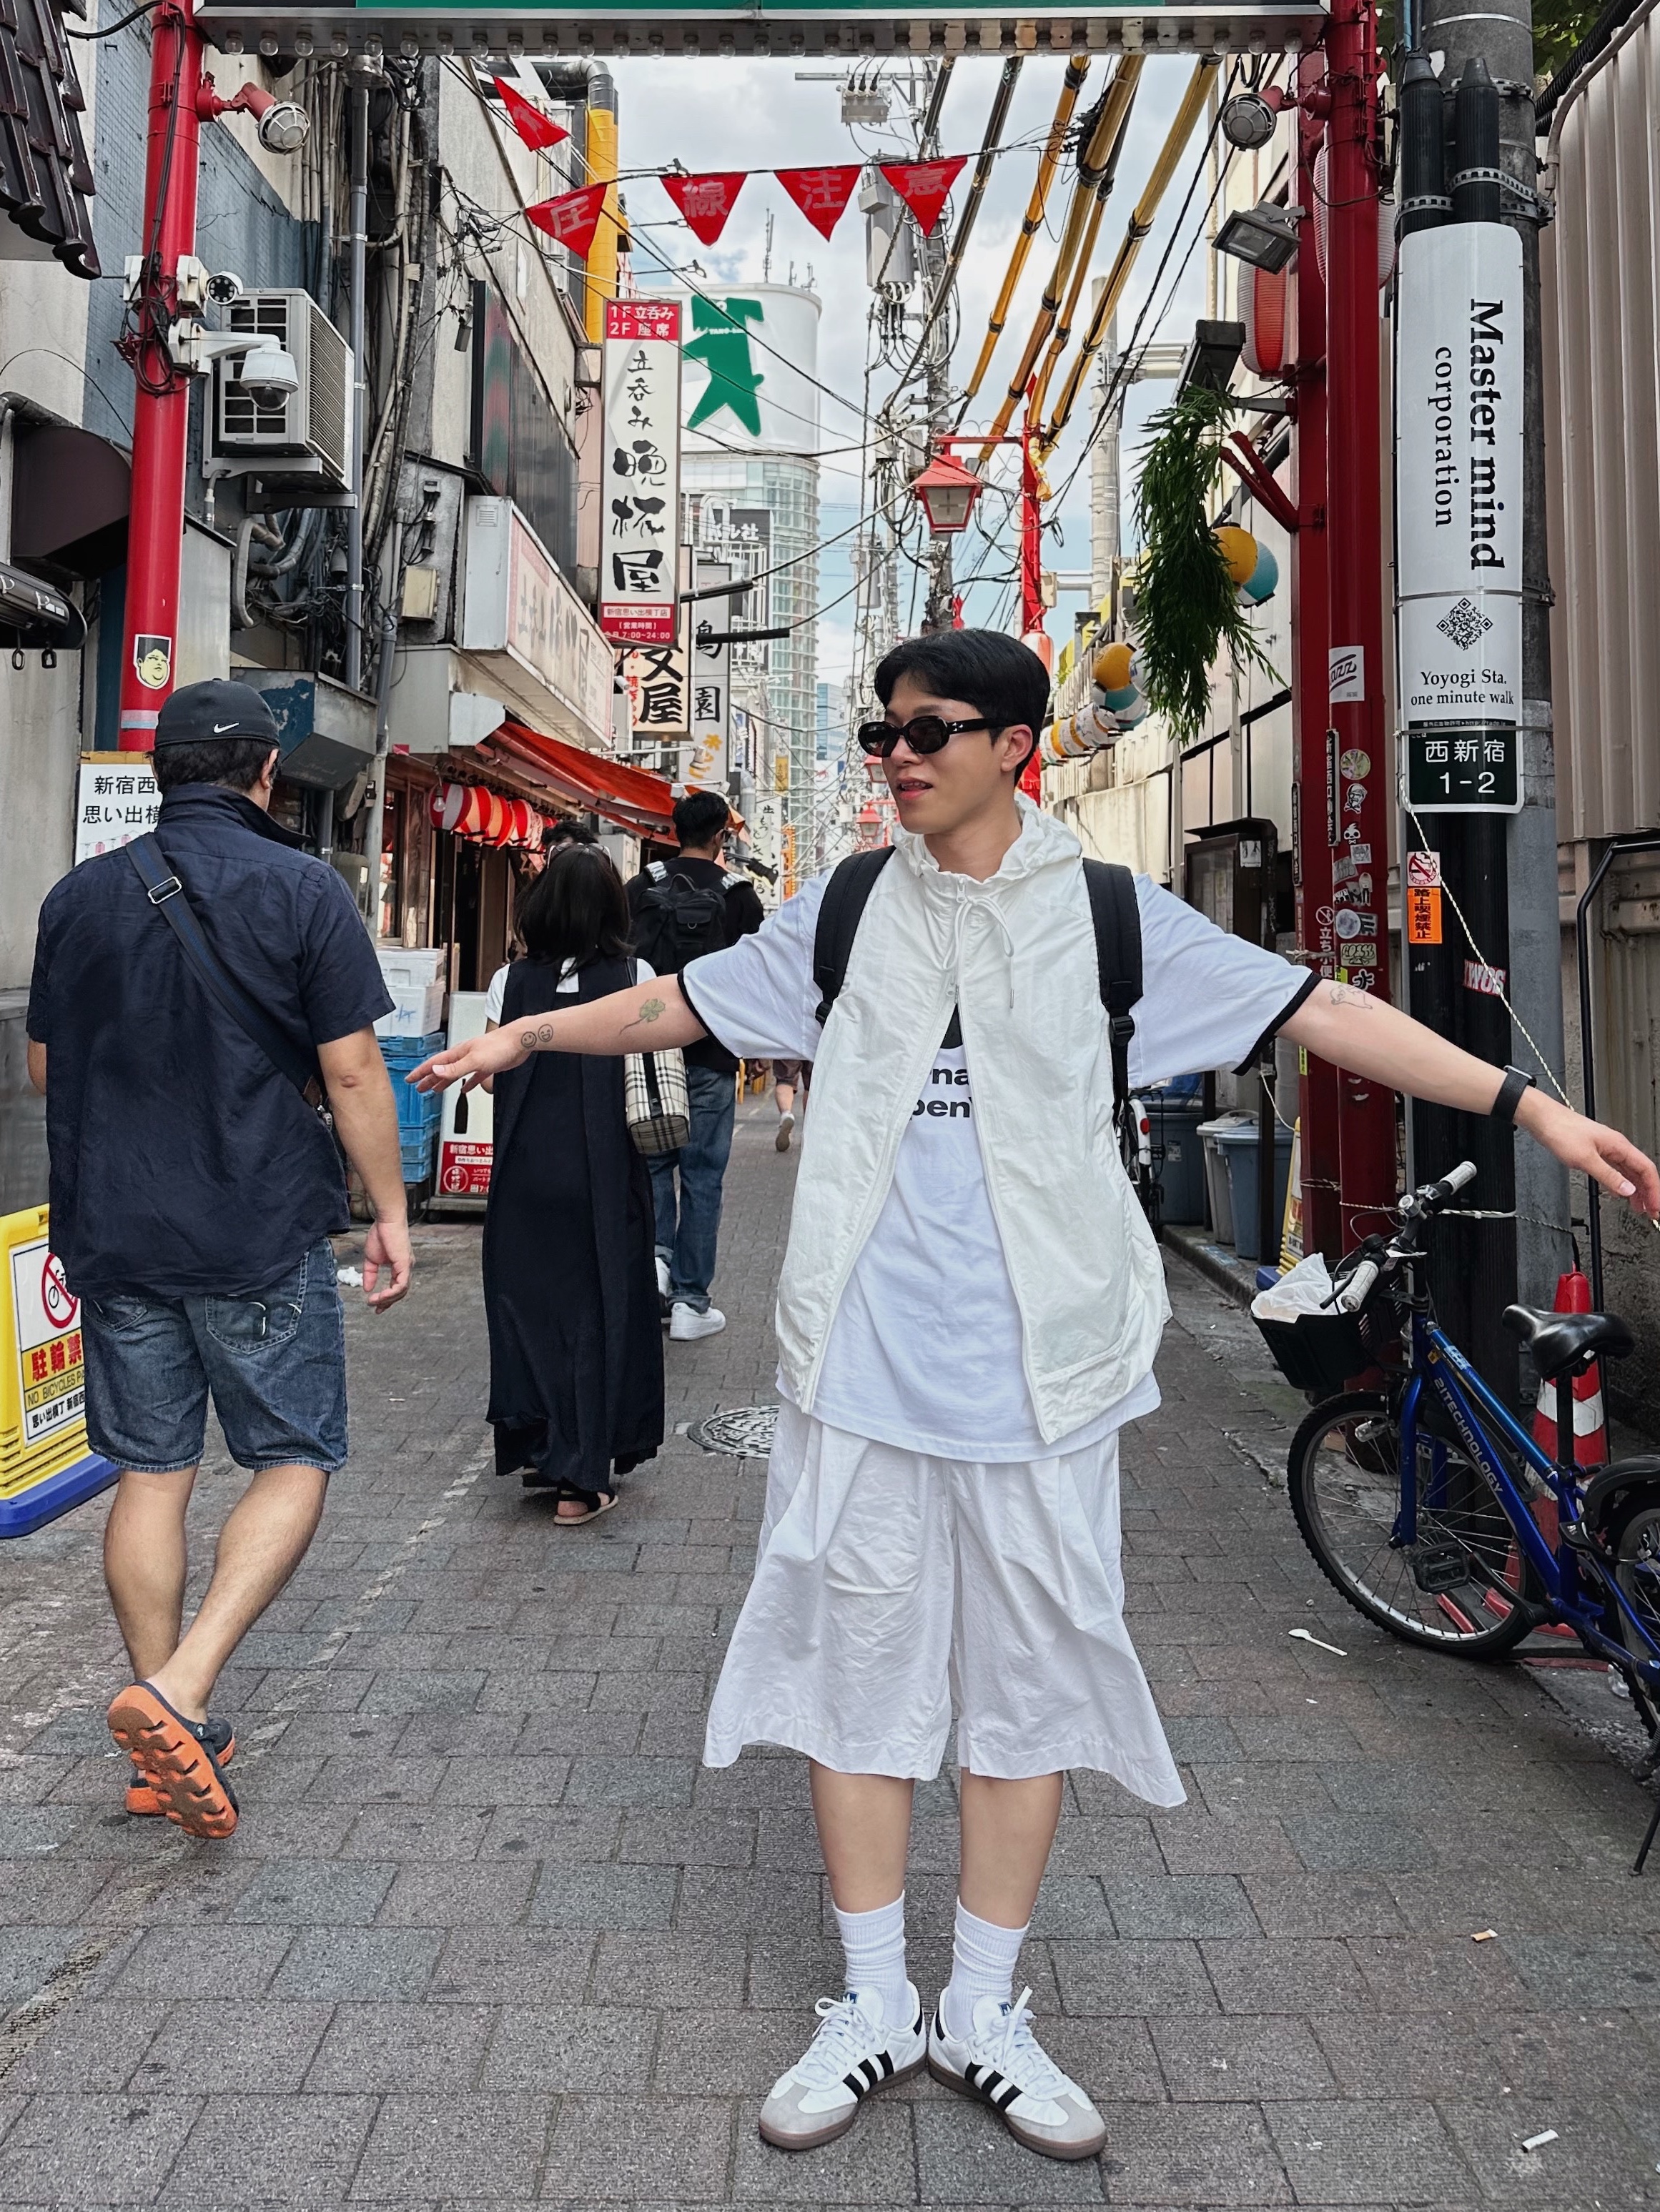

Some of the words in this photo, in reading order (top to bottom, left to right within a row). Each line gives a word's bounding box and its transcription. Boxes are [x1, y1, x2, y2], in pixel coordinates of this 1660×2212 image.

[610, 322, 631, 335] 2F
[611, 306, 631, 319] 1F
[635, 306, 675, 321] 立呑み
[1470, 299, 1503, 445] Master
[626, 349, 656, 430] 立呑み
[1428, 346, 1460, 527] corporation
[613, 440, 668, 593] 晩杯屋
[1470, 457, 1506, 570] mind
[1421, 669, 1476, 689] Yoyogi
[1481, 669, 1507, 684] Sta.
[1410, 695, 1433, 705] one
[1436, 690, 1486, 704] minute
[1489, 690, 1514, 705] walk
[1425, 739, 1505, 763] 西新宿
[94, 775, 156, 795] 新宿西
[1439, 771, 1496, 794] 1-2
[1414, 888, 1433, 939] 路上喫煙禁止
[31, 1333, 81, 1382] 駐輪禁
[27, 1391, 39, 1407] NO
[42, 1373, 76, 1401] BICYCLES
[32, 1401, 65, 1429] 思い出横丁
